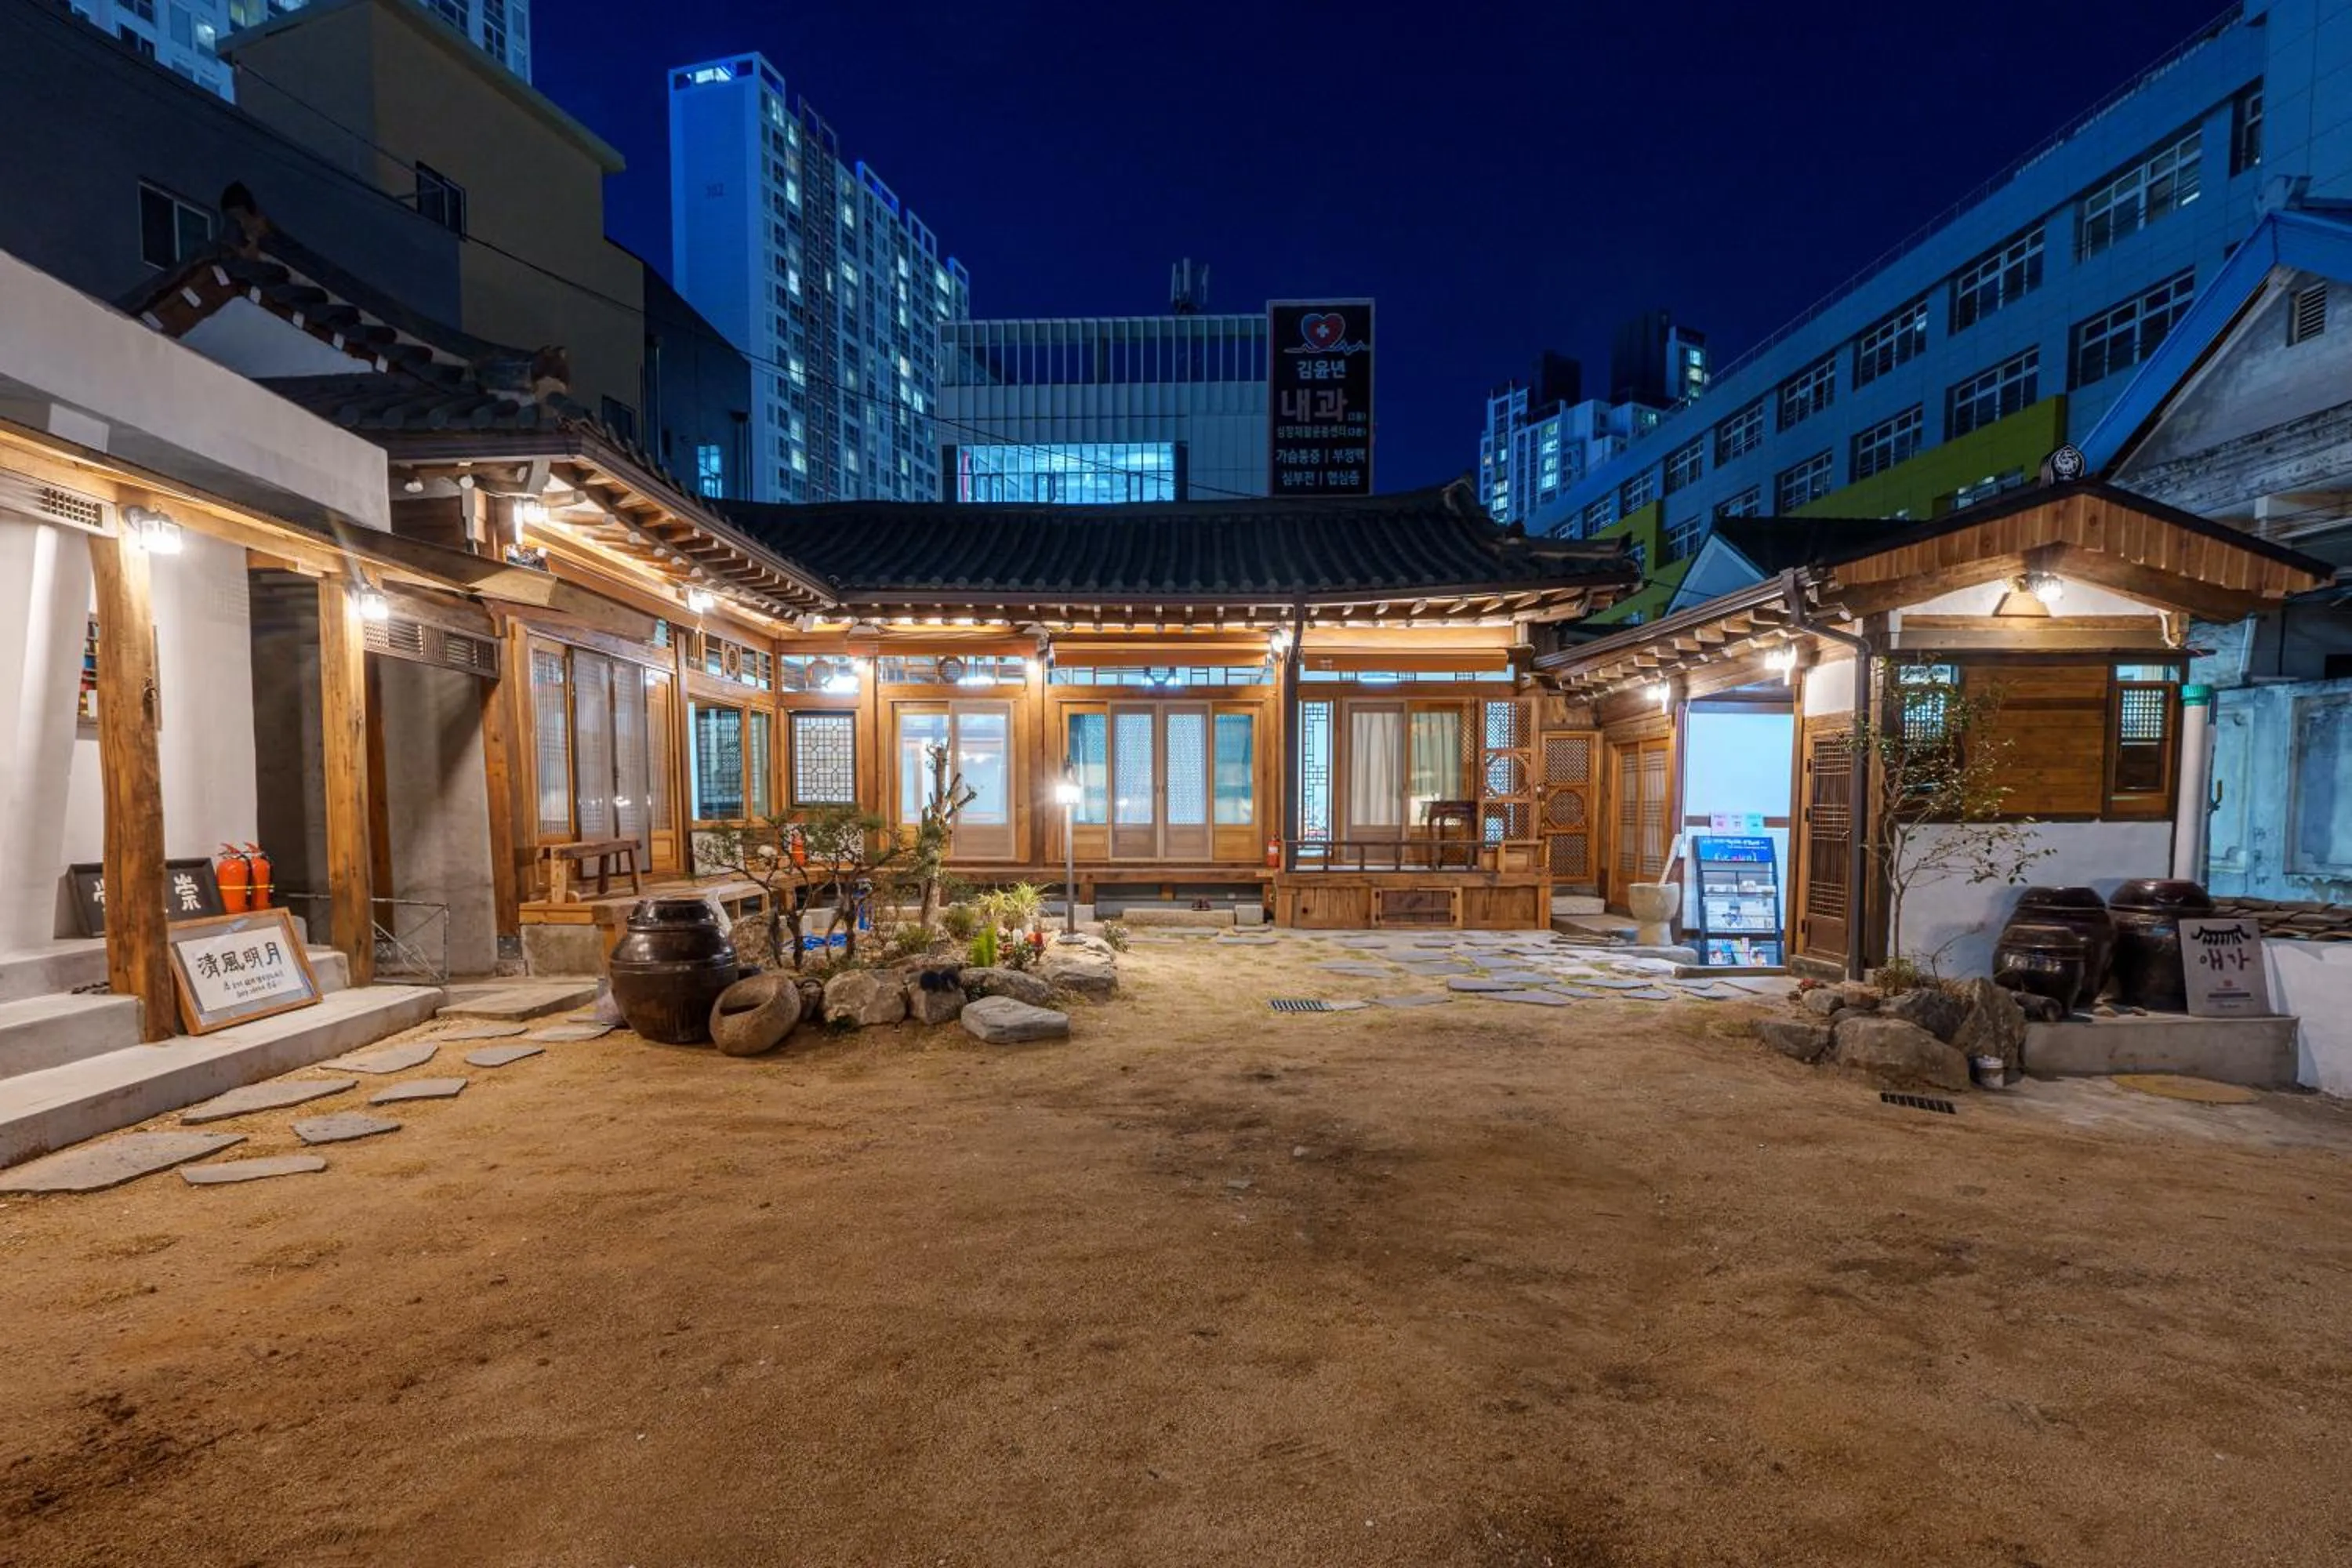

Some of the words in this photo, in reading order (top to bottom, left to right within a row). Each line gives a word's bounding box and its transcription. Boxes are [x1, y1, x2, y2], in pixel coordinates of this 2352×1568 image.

[1281, 388, 1348, 423] 내과
[1276, 448, 1321, 465] 가슴통증
[1332, 448, 1367, 464] 부정맥
[1282, 470, 1316, 486] 심부전
[2199, 947, 2251, 971] 애가
